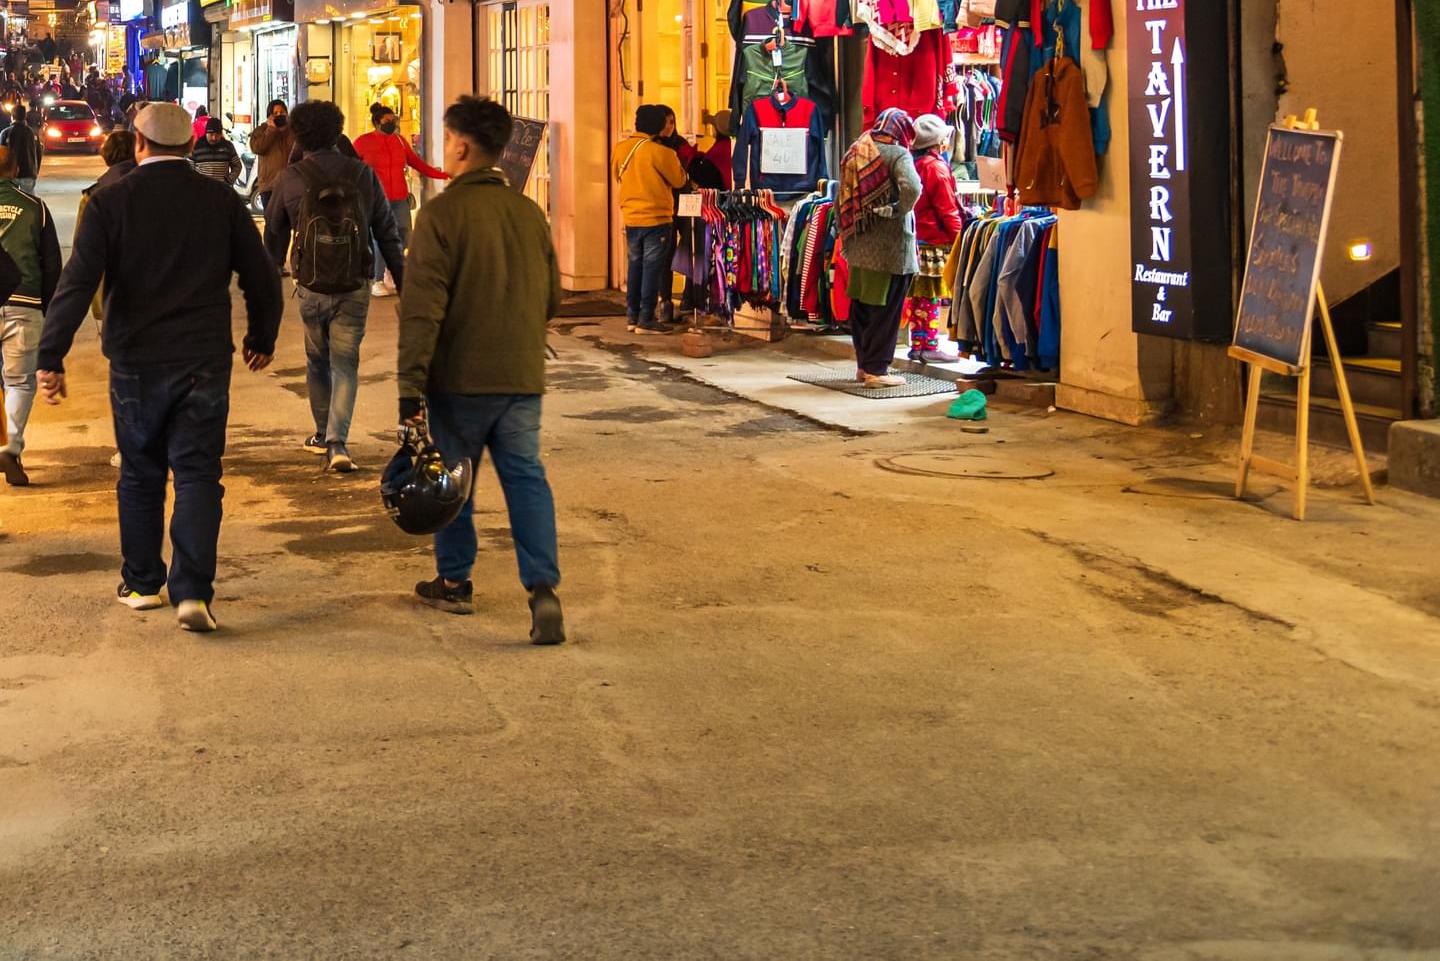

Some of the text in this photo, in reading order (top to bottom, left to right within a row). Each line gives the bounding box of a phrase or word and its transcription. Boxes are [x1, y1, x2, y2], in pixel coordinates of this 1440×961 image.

[1144, 19, 1172, 262] TAVERN
[1134, 264, 1188, 287] Restaurant
[1157, 287, 1166, 302] &
[1152, 303, 1172, 323] Bar
